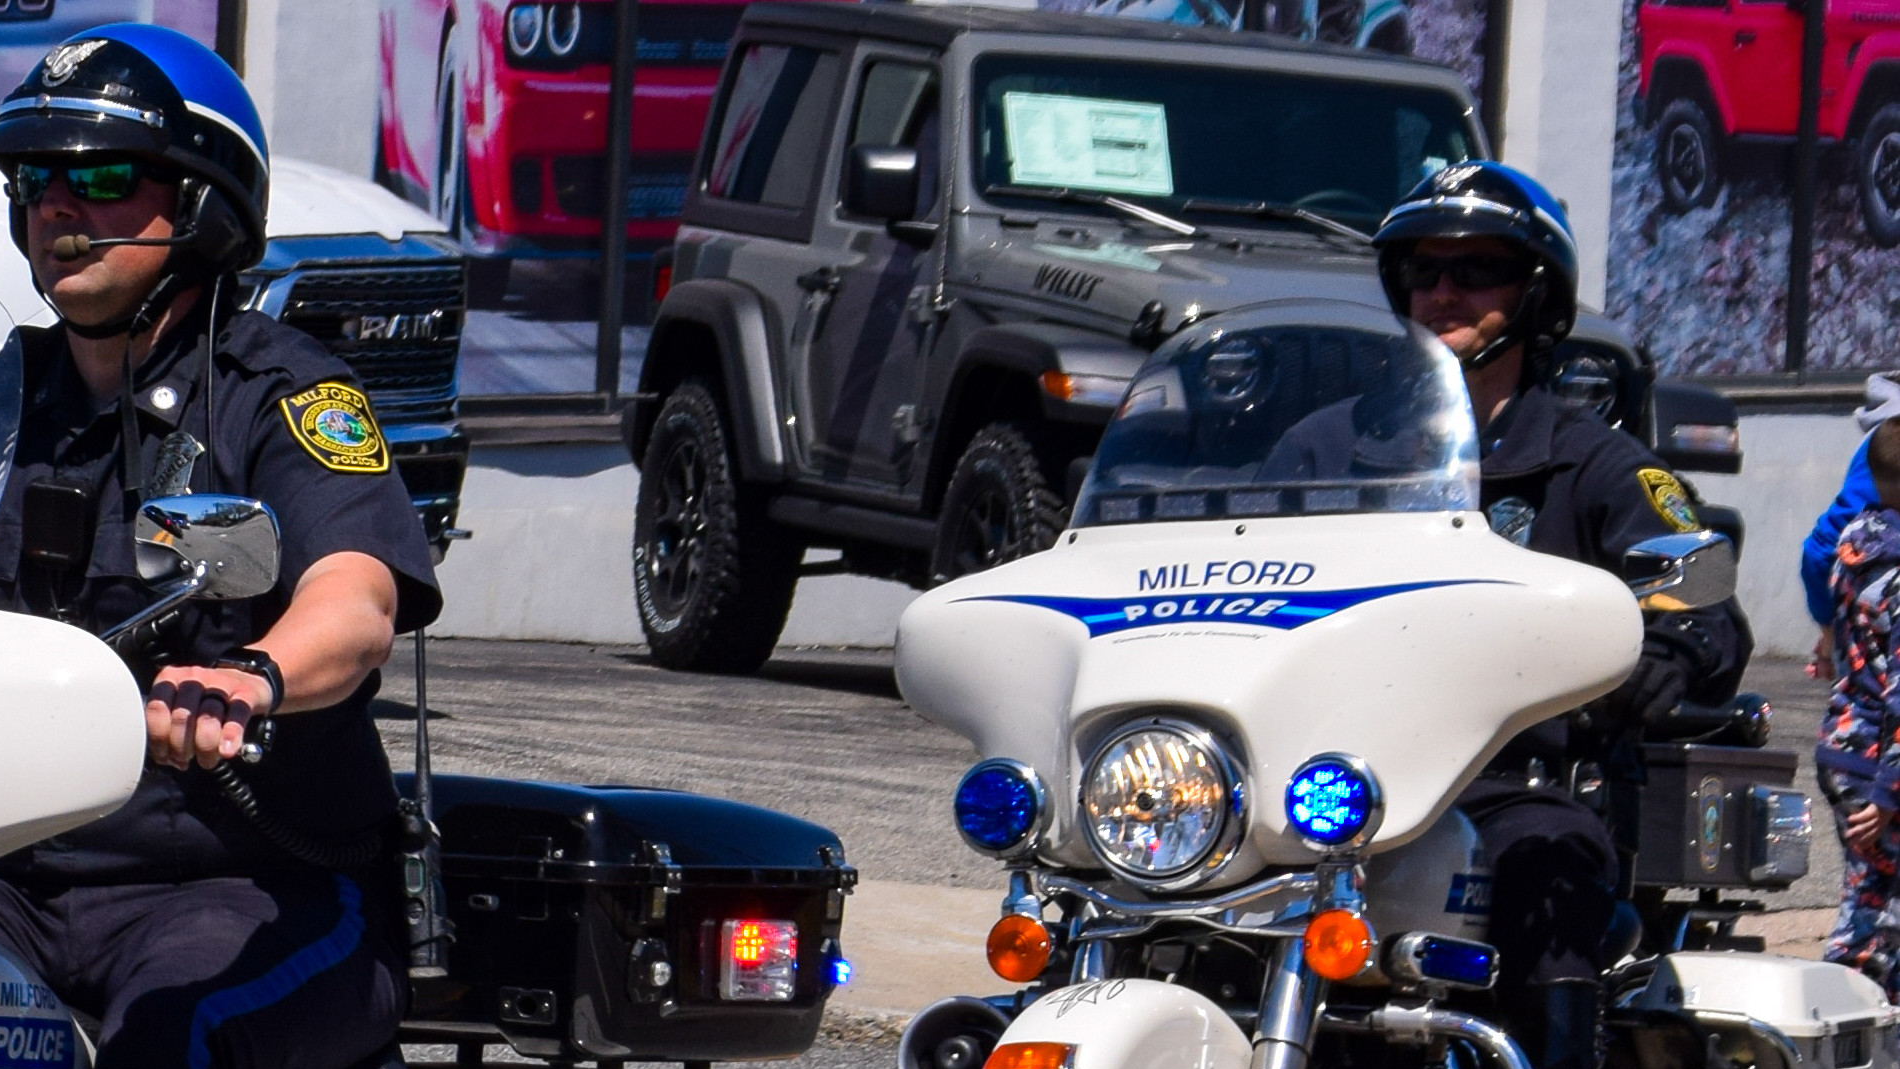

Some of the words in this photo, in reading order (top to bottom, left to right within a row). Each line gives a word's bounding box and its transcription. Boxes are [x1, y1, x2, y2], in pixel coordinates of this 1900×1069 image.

[1034, 263, 1105, 302] WILLYS
[289, 388, 363, 408] MILFORD
[330, 455, 379, 467] POLICE
[1139, 560, 1316, 591] MILFORD
[1124, 598, 1289, 622] POLICE
[0, 982, 56, 1009] MILFORD
